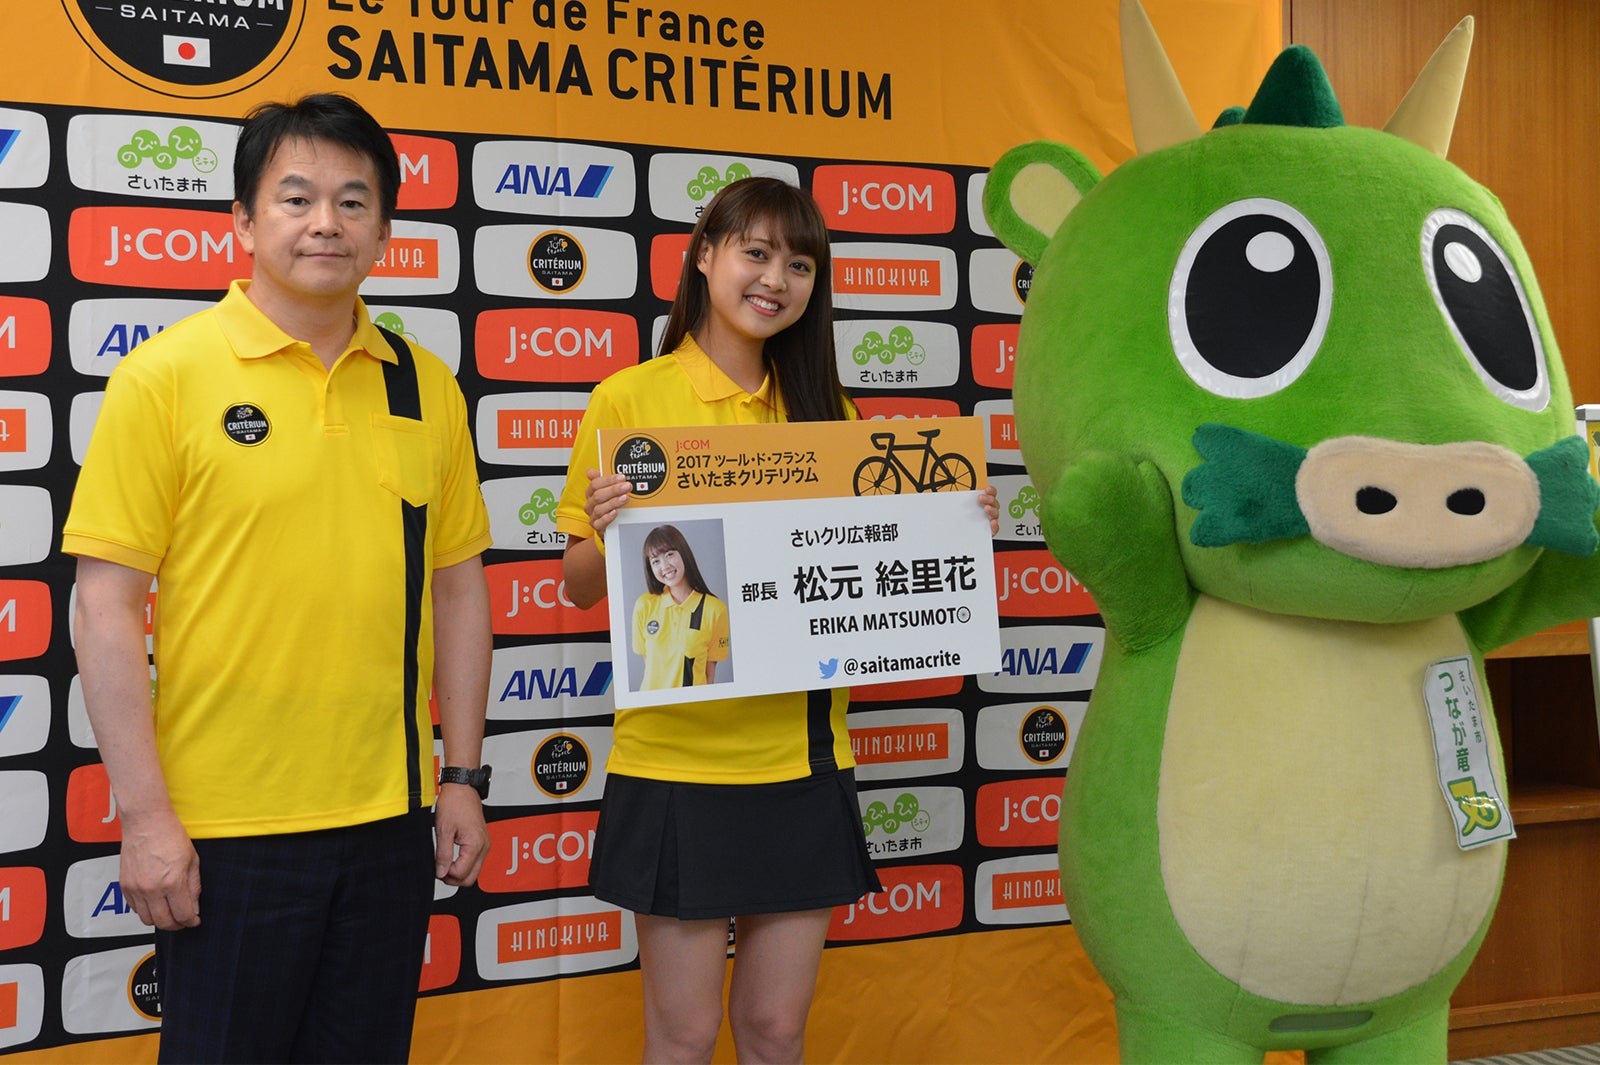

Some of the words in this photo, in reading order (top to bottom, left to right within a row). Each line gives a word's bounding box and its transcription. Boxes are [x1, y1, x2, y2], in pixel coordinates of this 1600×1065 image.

[120, 4, 250, 30] SAITAMA
[532, 0, 587, 31] de
[607, 0, 765, 50] France
[327, 24, 594, 96] SAITAMA
[608, 48, 892, 120] CRITÉRIUM
[128, 174, 207, 193] さいたま市
[495, 164, 571, 197] ANA
[838, 181, 932, 216] J:COM
[104, 226, 234, 267] J:COM
[533, 257, 582, 270] CRITÉRIUM
[844, 266, 930, 288] HINOKIYA
[97, 324, 164, 357] AN
[504, 326, 613, 364] J:COM
[860, 369, 918, 383] さいたま市
[227, 419, 267, 431] CRITÉRIUM
[675, 439, 711, 454] J:COM
[616, 461, 666, 475] CRITÉRIUM
[676, 454, 711, 469] 2017
[714, 451, 817, 468] ツール・ド・フランス
[677, 467, 819, 489] さいたまクリテリウム
[790, 523, 899, 547] さいクリ広報部
[741, 581, 778, 602] 部長
[793, 564, 863, 604] 松元
[875, 555, 977, 597] 絵里花
[809, 616, 859, 636] ERIKA
[843, 650, 961, 676] @saitamacrite
[500, 667, 578, 702] ANA
[851, 732, 938, 756] HINOKIYA
[1024, 731, 1064, 743] CRITÉRIUM
[537, 761, 586, 774] CRITÉRIUM
[1000, 794, 1061, 831] J:CO
[1003, 876, 1061, 900] HINOKI
[511, 921, 609, 951] HINOKIYA
